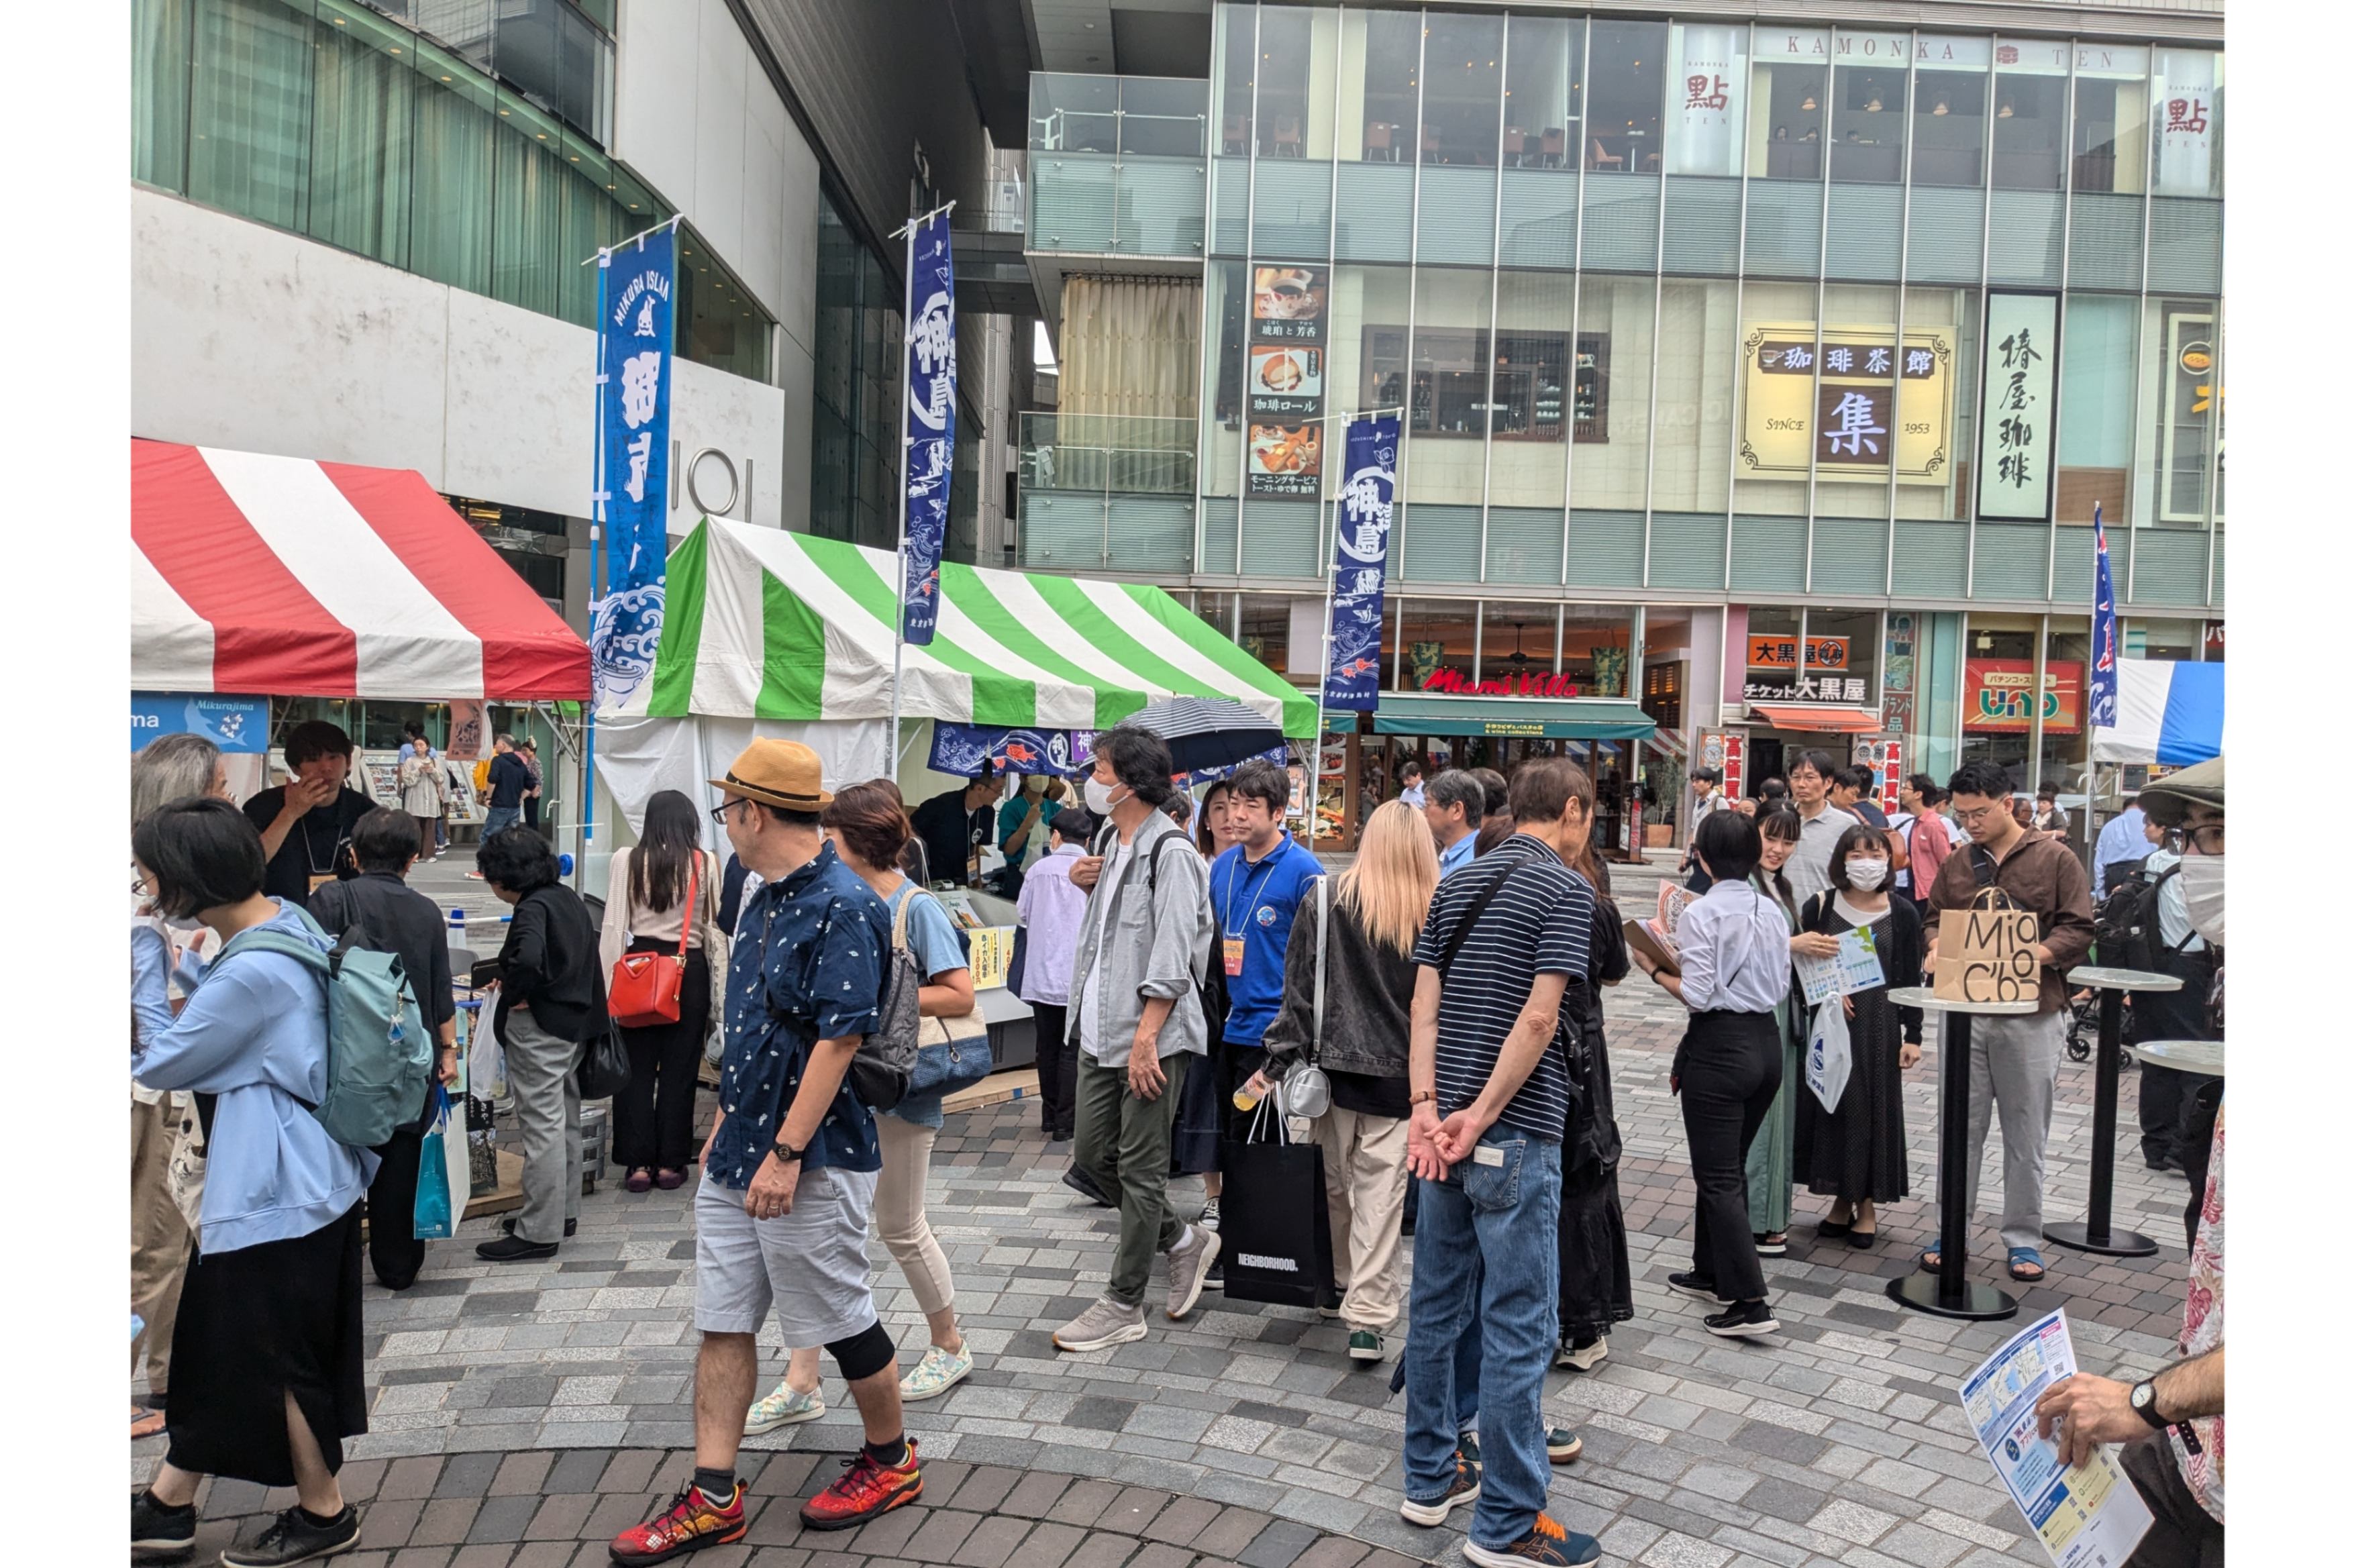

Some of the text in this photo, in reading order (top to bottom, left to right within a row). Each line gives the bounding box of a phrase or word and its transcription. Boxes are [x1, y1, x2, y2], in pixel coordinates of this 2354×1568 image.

[1787, 36, 2112, 68] KAMONKA TEN
[1685, 74, 1729, 111] 點
[1685, 117, 1727, 125] TEN
[2166, 99, 2208, 134] 點
[2167, 140, 2206, 148] TEN
[613, 273, 645, 327] MIKURA
[1784, 346, 1934, 375] 珈琲茶館
[1253, 398, 1317, 413] 珈琲ロール
[1998, 327, 2043, 489] 椿屋珈琲
[1766, 418, 1931, 435] SINCE 1953
[1823, 392, 1886, 456] 集
[1251, 475, 1318, 485] モーニングサービス
[1756, 643, 1816, 664] 大黒屋
[1422, 668, 1578, 697] Miami Villa
[1743, 677, 1865, 701] チケット大黒屋
[1990, 676, 2051, 684] パチンコ・スト
[196, 700, 254, 712] Mikurajima
[1888, 717, 1902, 731] 品
[1964, 912, 2038, 957] Mia
[1238, 1253, 1298, 1272] NEIGHBORHOOD.
